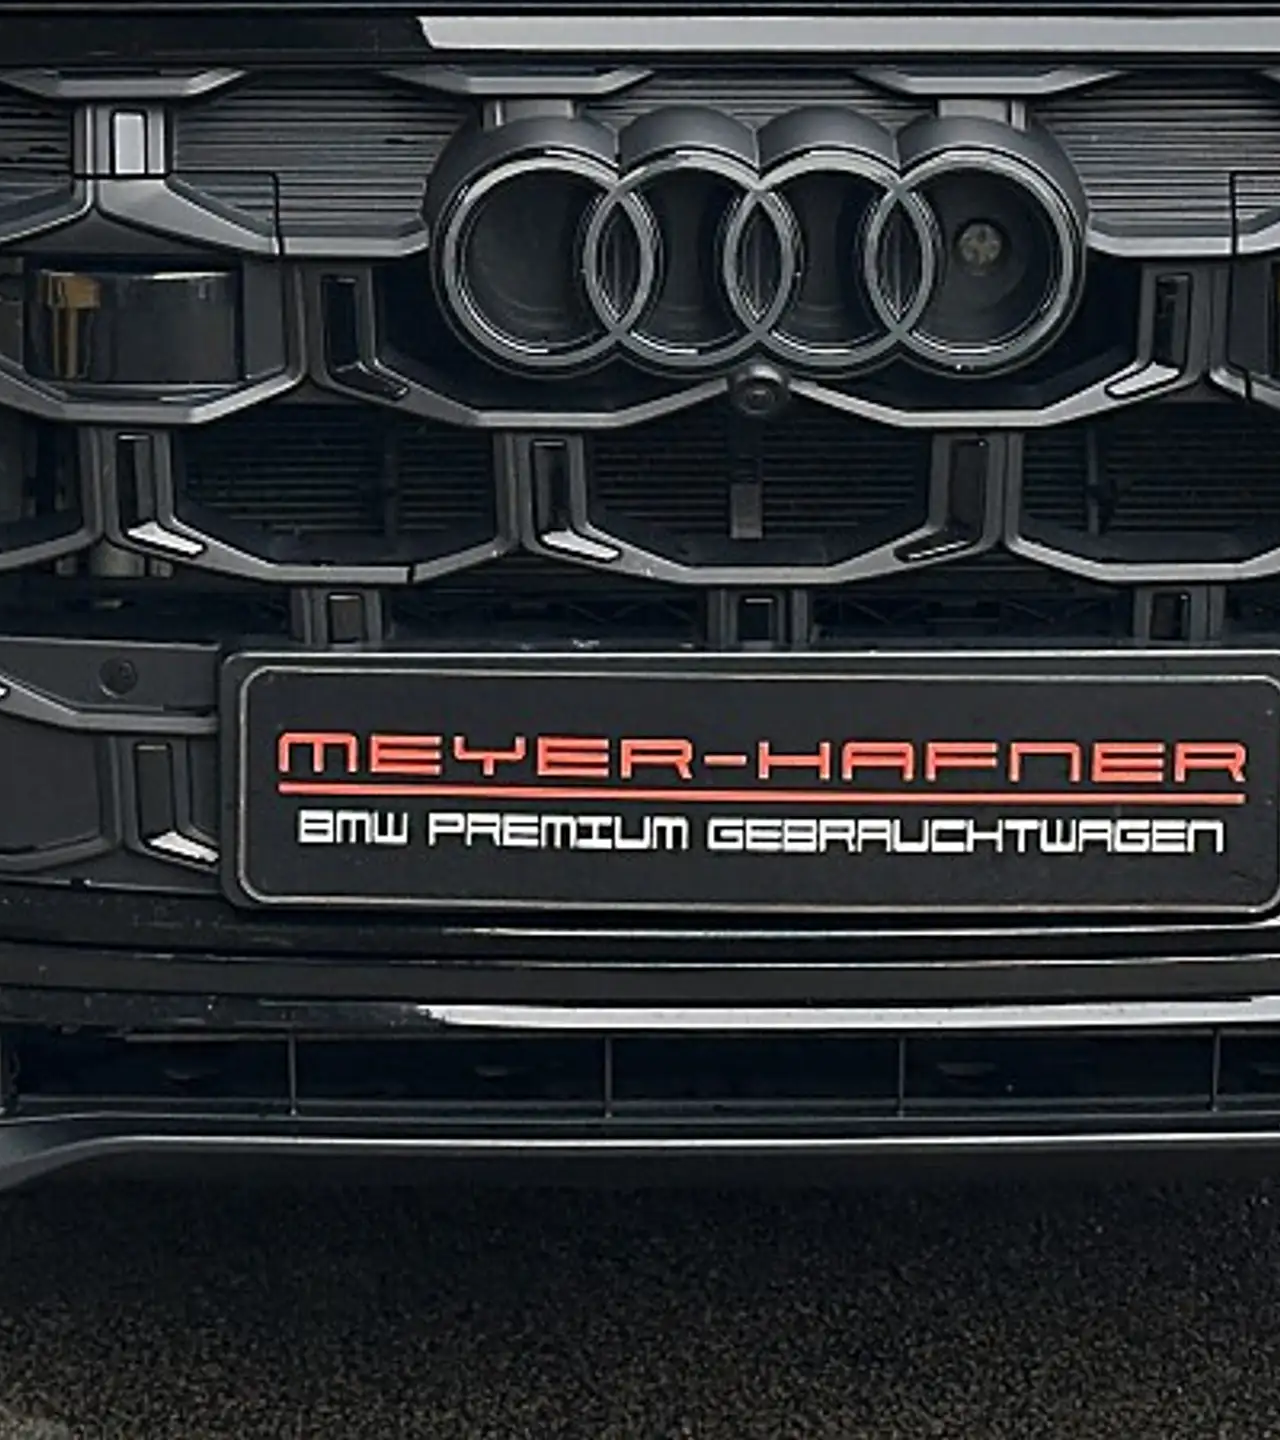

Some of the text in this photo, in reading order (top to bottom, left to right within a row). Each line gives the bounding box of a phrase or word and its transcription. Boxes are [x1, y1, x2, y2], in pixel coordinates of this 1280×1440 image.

[278, 732, 1246, 783] MEYER-HAFNER
[298, 809, 1224, 854] BMW PREMIUM GEBRAUCHTWAGEN
